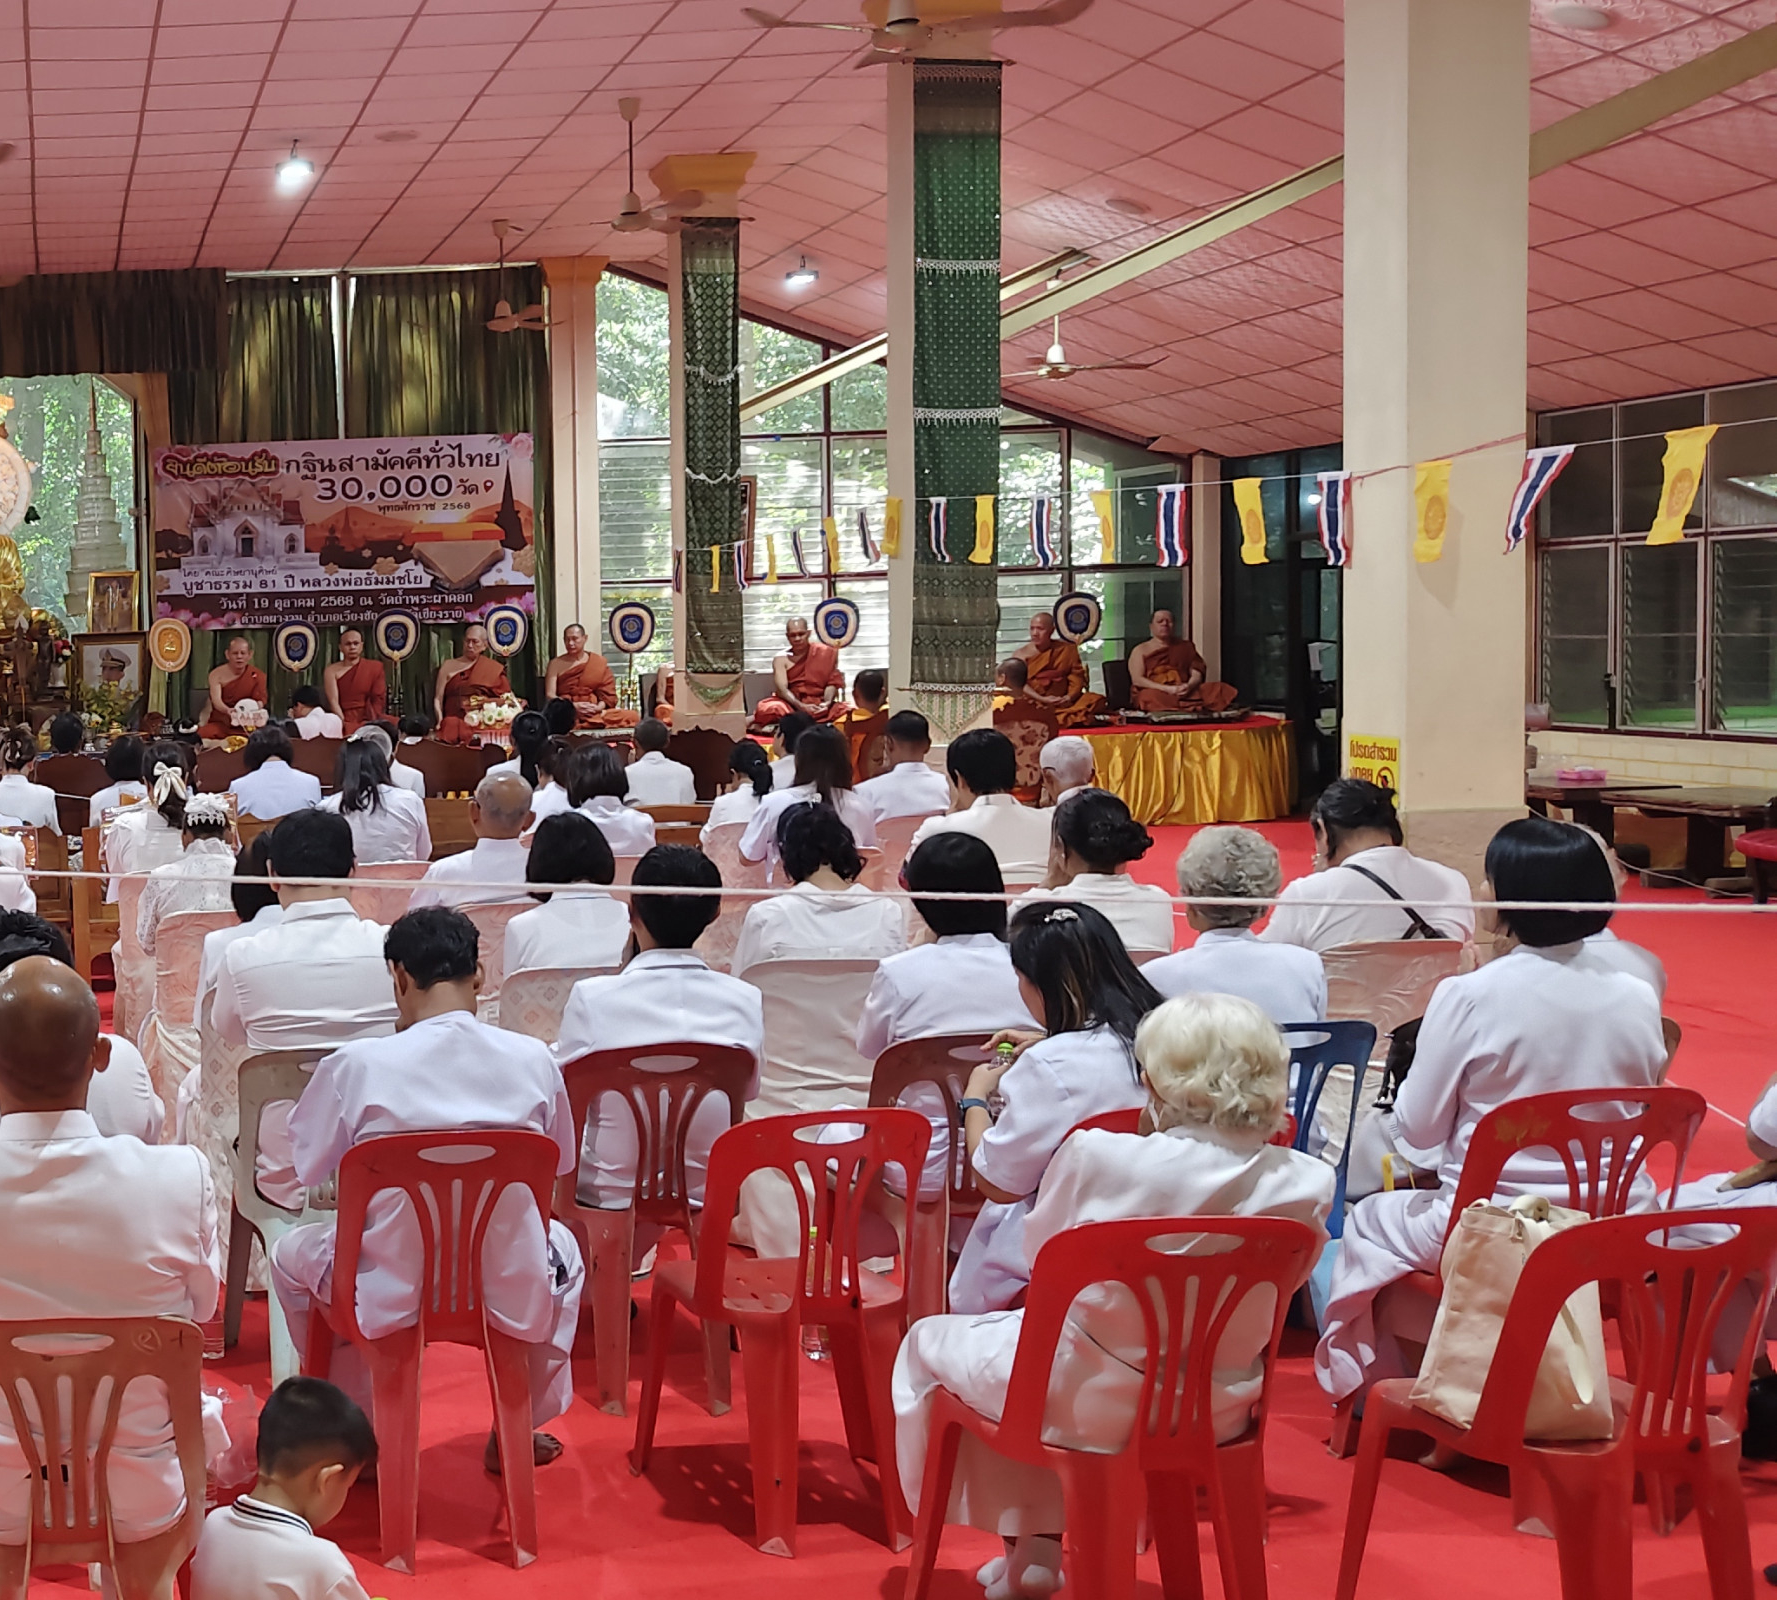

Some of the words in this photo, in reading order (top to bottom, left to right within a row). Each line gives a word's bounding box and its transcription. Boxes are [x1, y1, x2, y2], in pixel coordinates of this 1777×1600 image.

[284, 440, 501, 481] กฐินสามัคคีทั่วไทย
[316, 474, 453, 502] 30,000
[456, 478, 480, 496] วัด
[442, 502, 471, 511] 2568
[181, 579, 253, 596] บูชาธรรม
[258, 578, 277, 589] 81
[284, 575, 296, 589] ปี
[299, 569, 423, 588] หลวงพ่อธัมมชโย
[182, 567, 200, 578] โดย
[219, 594, 247, 610] วันที่
[253, 597, 269, 609] 19
[274, 597, 315, 611] ตุลาคม
[320, 596, 354, 607] 2568
[359, 596, 374, 606] ณ
[1349, 740, 1397, 762] โปรดสำรวม
